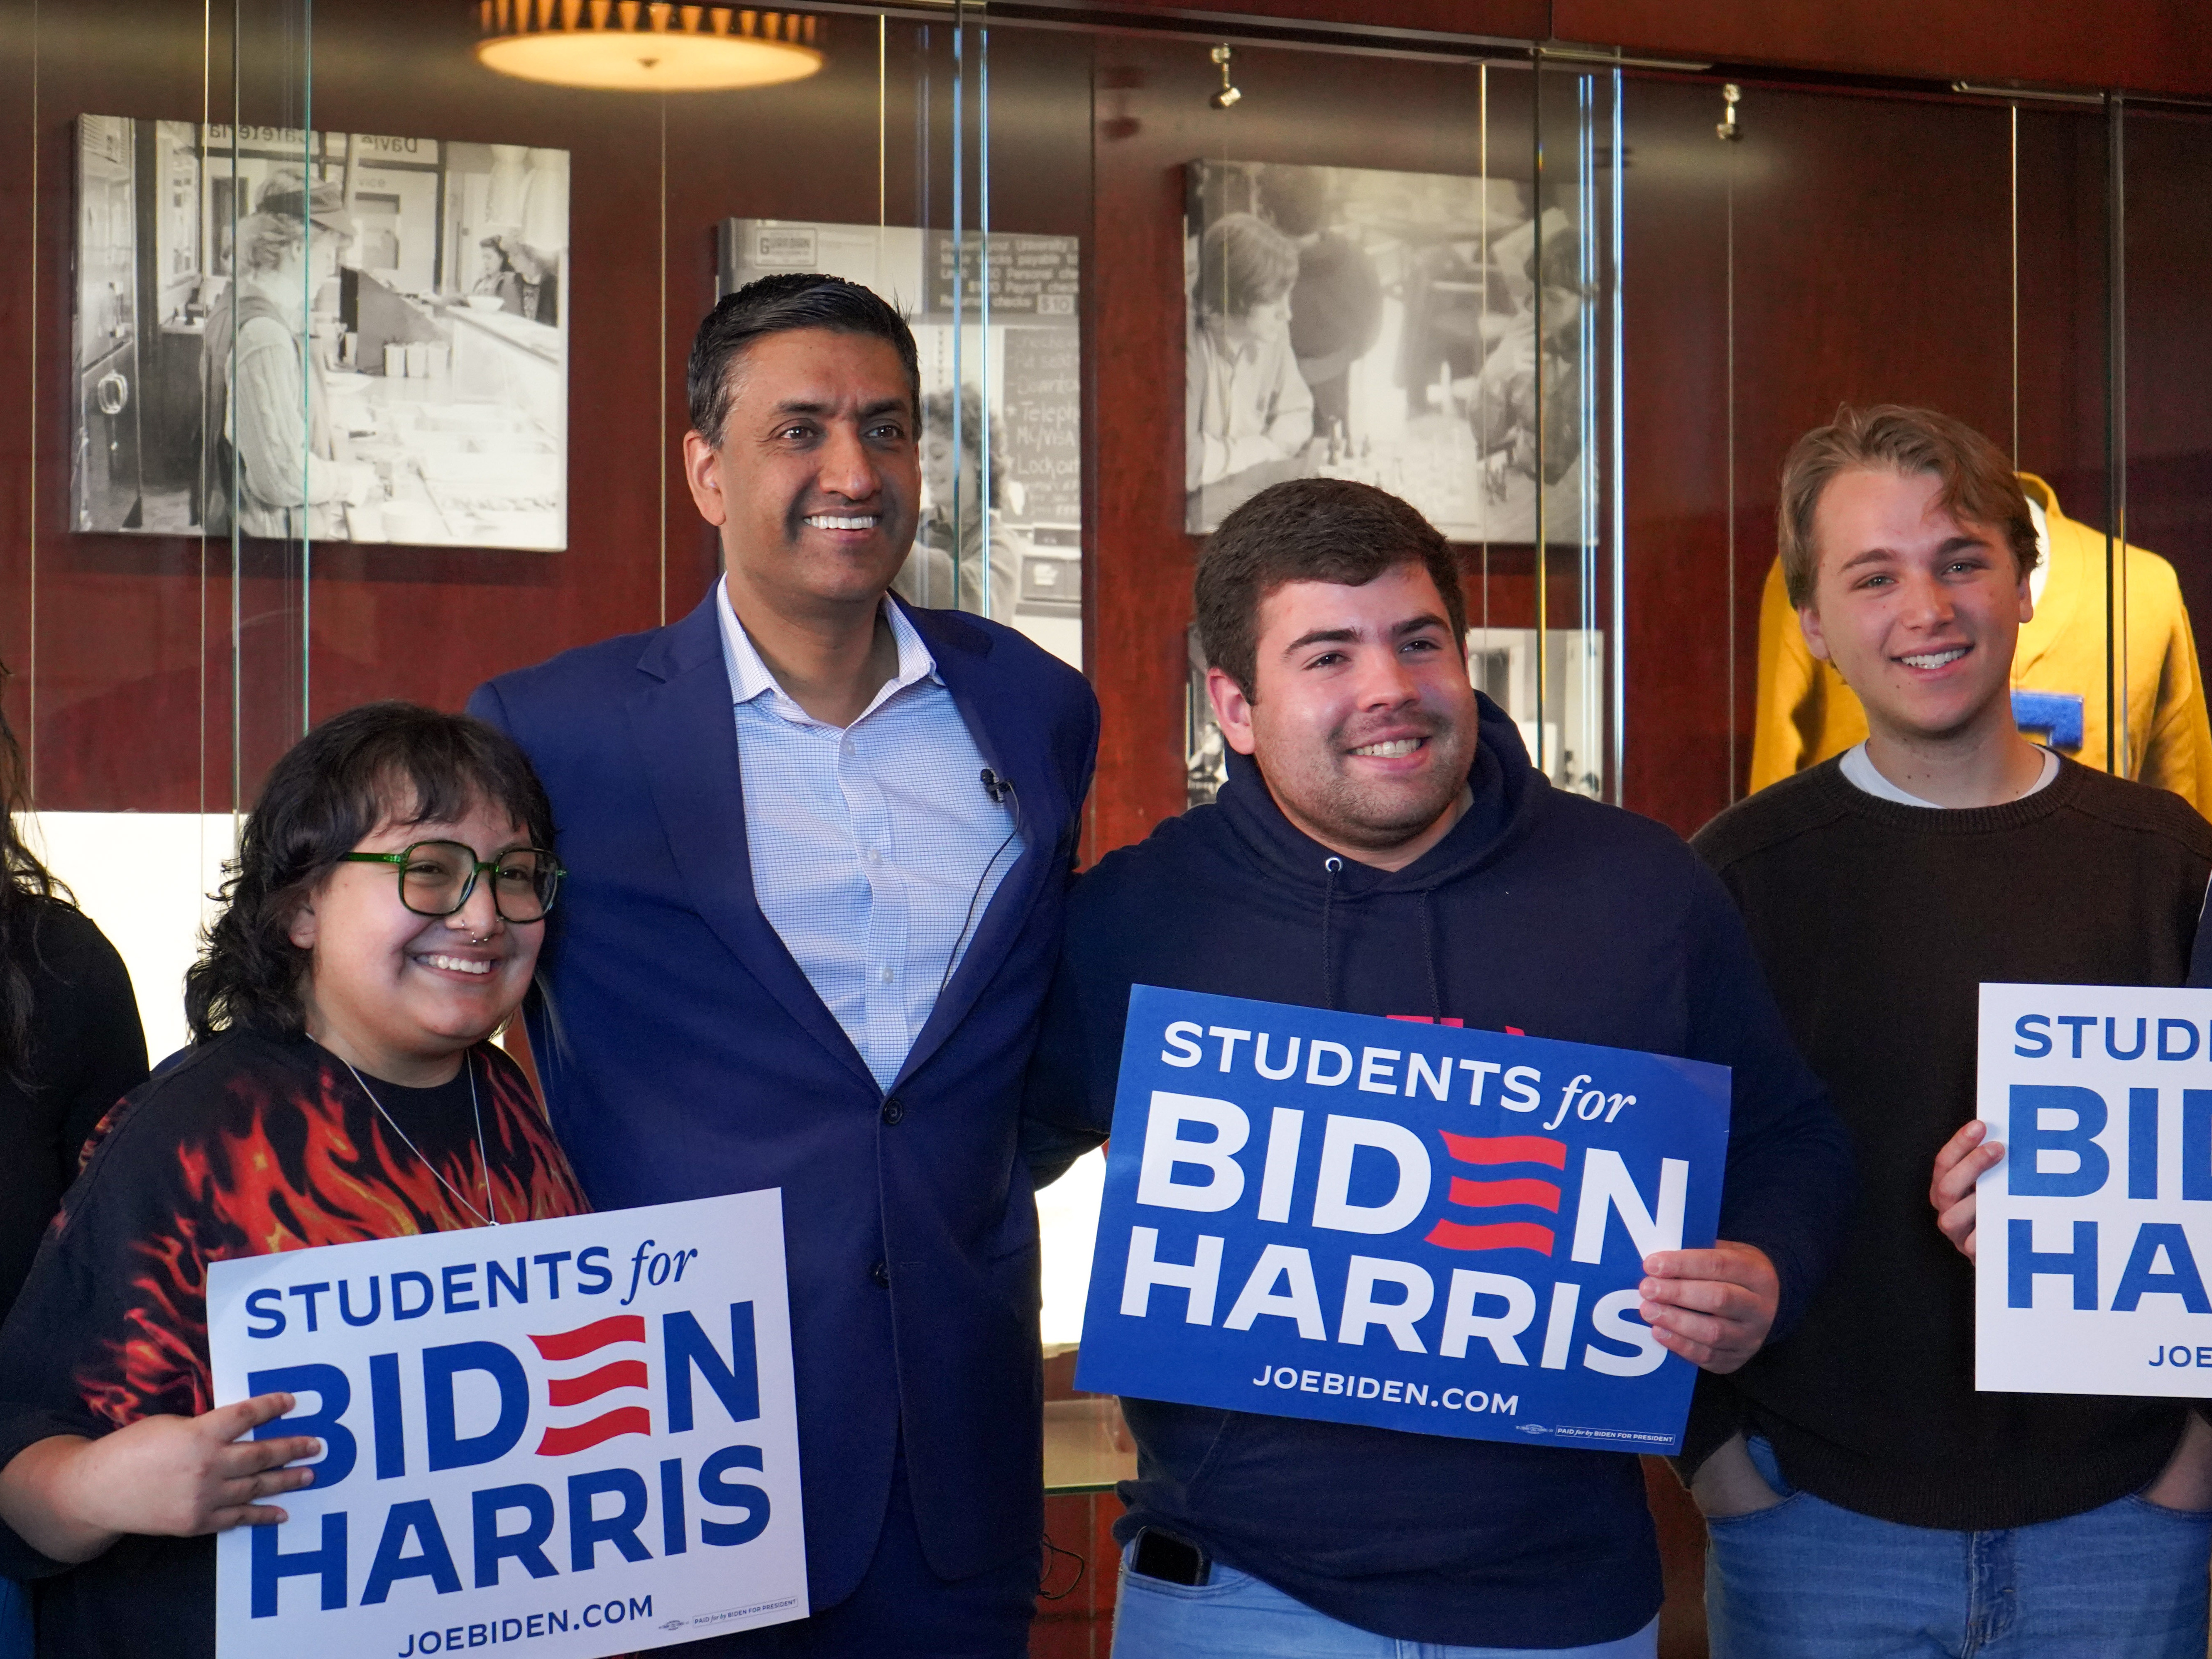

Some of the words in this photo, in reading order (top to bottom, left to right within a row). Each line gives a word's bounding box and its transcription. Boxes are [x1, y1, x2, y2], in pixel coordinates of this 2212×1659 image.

[1160, 1021, 1541, 1113] STUDENTS
[1542, 1074, 1637, 1130] for
[2014, 1014, 2212, 1062] STUD
[1136, 1090, 1689, 1265] BIDEN
[2007, 1084, 2212, 1201] BI
[245, 1246, 613, 1339] STUDENTS
[619, 1239, 698, 1306] for
[1120, 1226, 1668, 1377] HARRIS
[2007, 1219, 2212, 1314] HA
[247, 1300, 761, 1491] BIDEN
[1253, 1365, 1520, 1416] JOEBIDEN.COM
[2149, 1345, 2212, 1368] JOE
[1633, 1434, 1674, 1442] PRESIDENT
[250, 1445, 771, 1620] HARRIS
[398, 1595, 653, 1659] JOEBIDEN.COM
[710, 1615, 719, 1623] for
[727, 1609, 747, 1618] BIDEN
[762, 1599, 796, 1611] PRESIDENT
